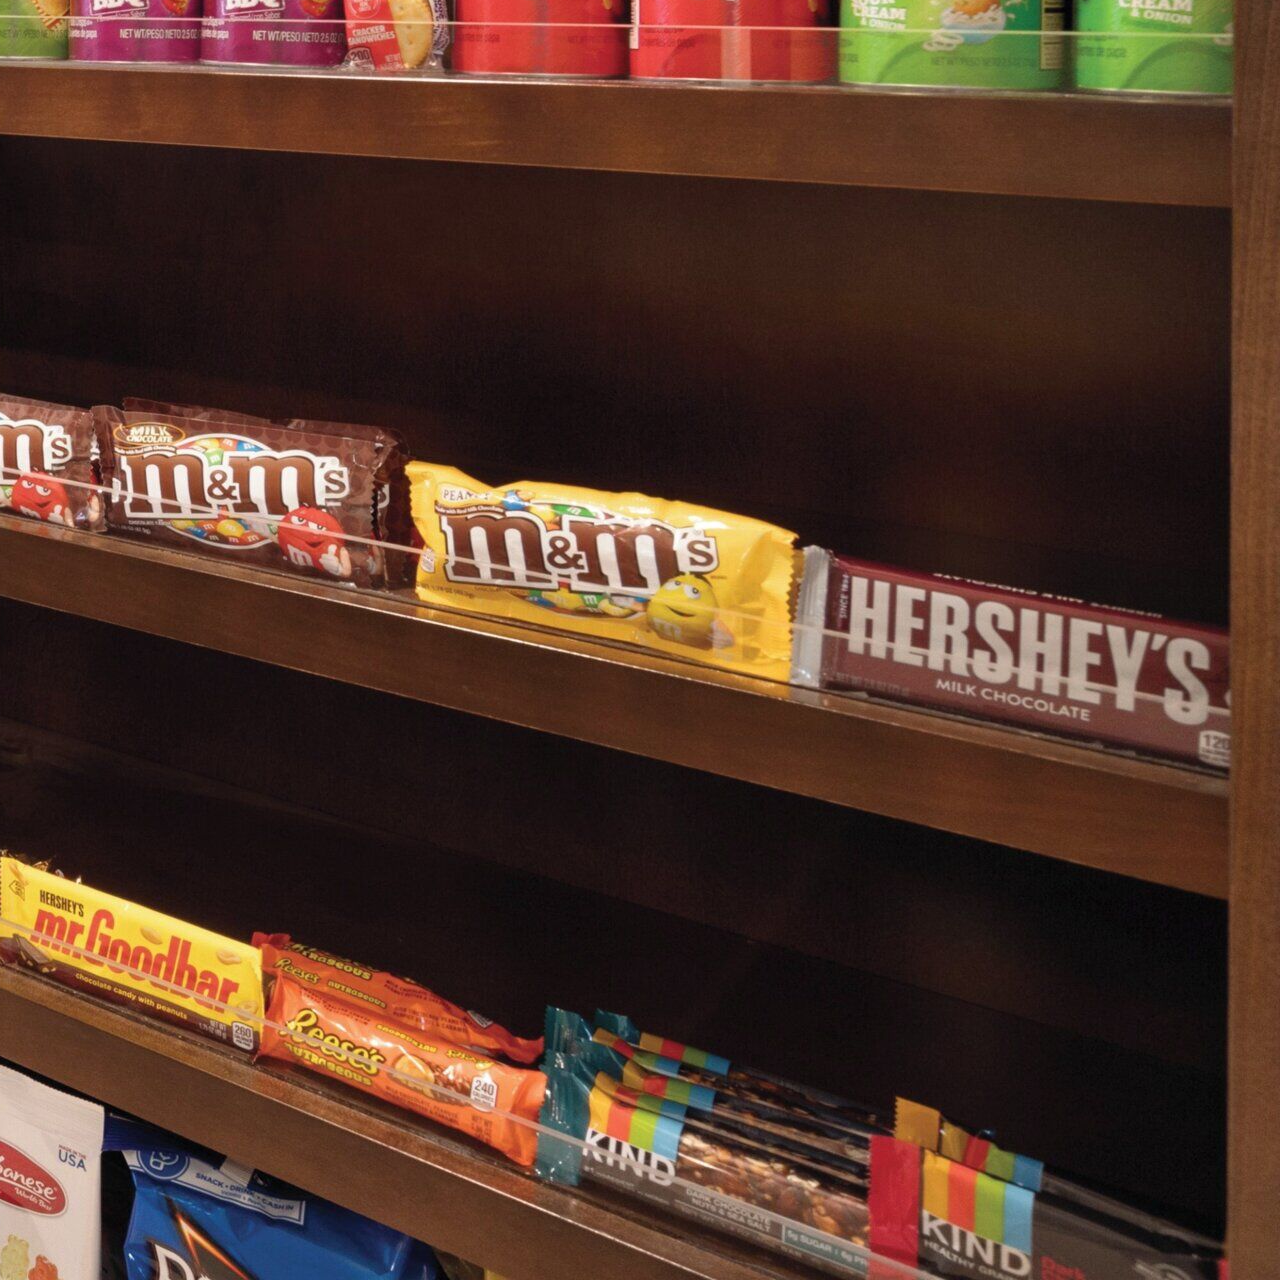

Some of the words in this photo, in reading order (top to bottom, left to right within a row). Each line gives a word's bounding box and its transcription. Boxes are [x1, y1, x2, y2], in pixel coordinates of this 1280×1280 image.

[853, 5, 907, 20] CREAM
[253, 30, 266, 41] NET
[352, 26, 386, 36] CRACKER
[126, 434, 174, 445] CHOCOLATE
[129, 424, 171, 437] MILK
[848, 575, 1210, 726] HERSHEY'S
[935, 677, 977, 699] MILK
[980, 686, 1092, 722] CHOCOLATE
[39, 889, 85, 918] HERSHEY'S
[75, 971, 113, 992] chocolate
[113, 986, 138, 1002] candy
[138, 994, 155, 1008] with
[155, 1002, 189, 1020] peanuts
[234, 1023, 253, 1038] 260
[279, 1008, 387, 1076] Reese's
[474, 1078, 495, 1096] 240
[58, 1148, 88, 1173] USA
[195, 1172, 224, 1190] SNACK
[921, 1209, 1032, 1277] KIND
